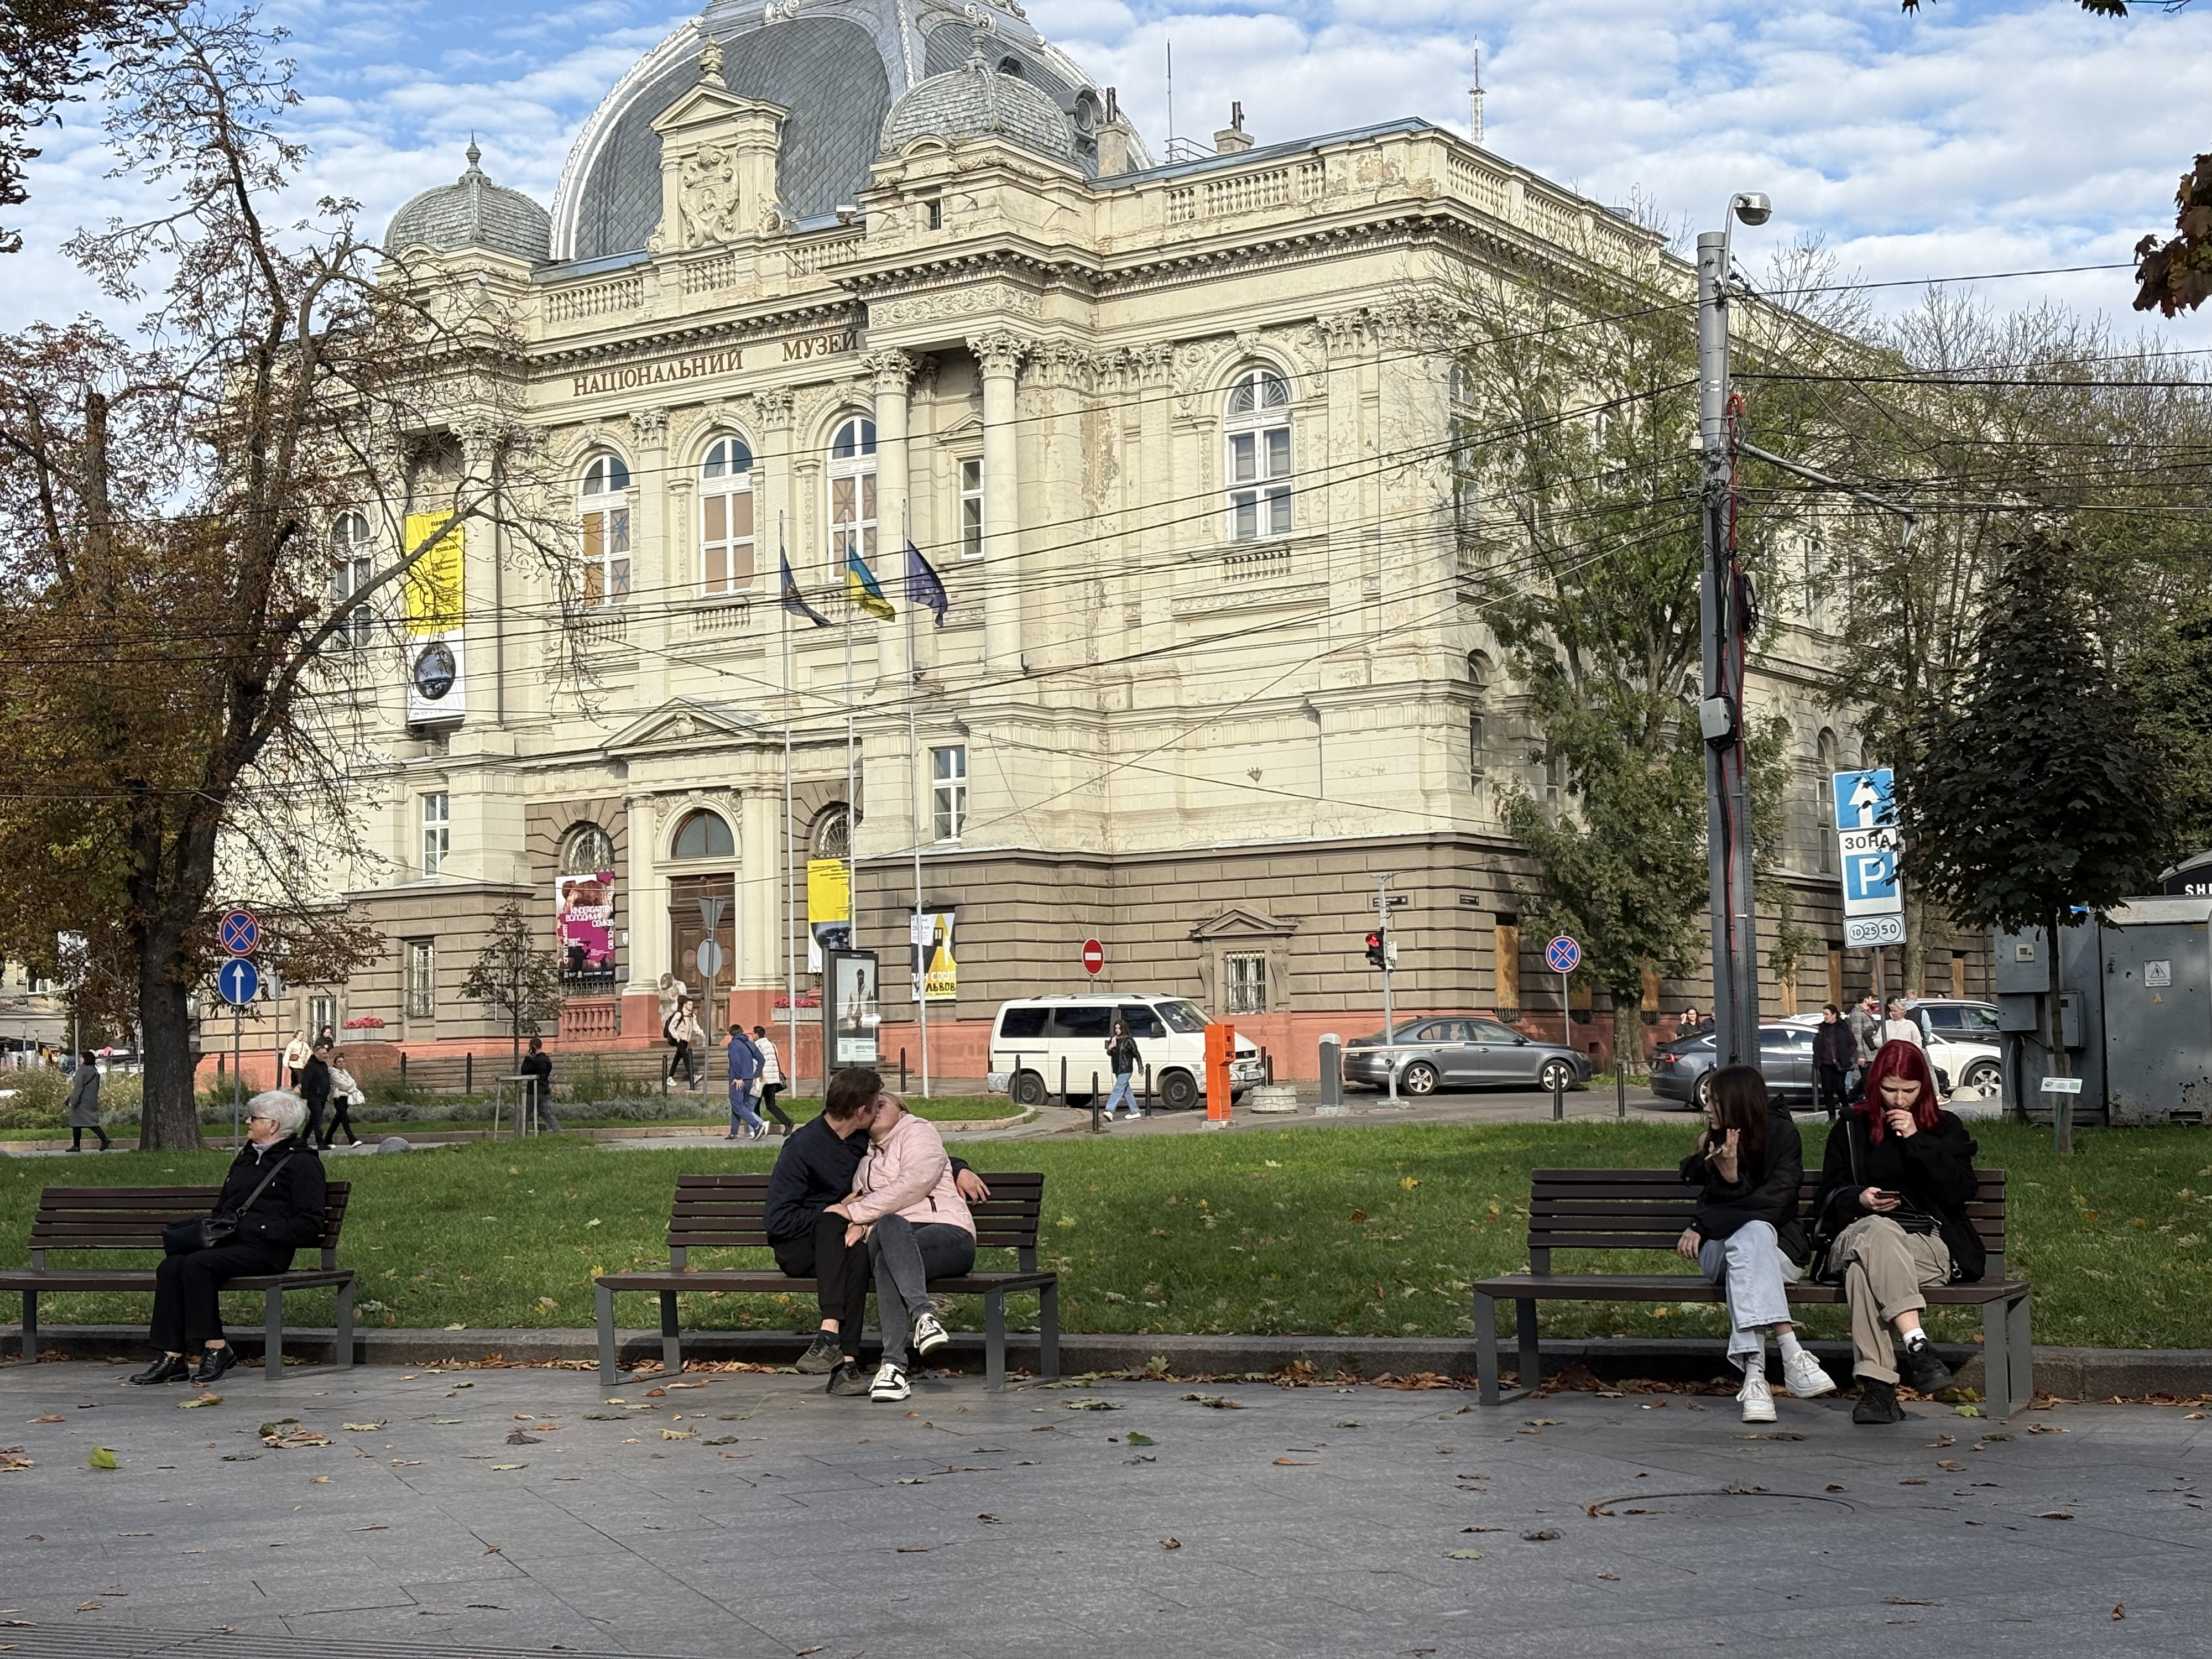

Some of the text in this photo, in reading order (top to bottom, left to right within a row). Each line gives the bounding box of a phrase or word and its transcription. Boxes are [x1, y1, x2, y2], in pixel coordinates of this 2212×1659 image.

[573, 328, 858, 397] НАЦІОНАЛЬНИЙ МУЗЕЙ
[1845, 834, 1891, 849] ЗОНА
[1859, 858, 1886, 895] P
[571, 905, 613, 914] KINDERGARTEN
[565, 913, 603, 922] ВОЛОДИМИР
[1865, 927, 1876, 935] 25
[1881, 924, 1896, 935] 50
[911, 972, 928, 982] ПН
